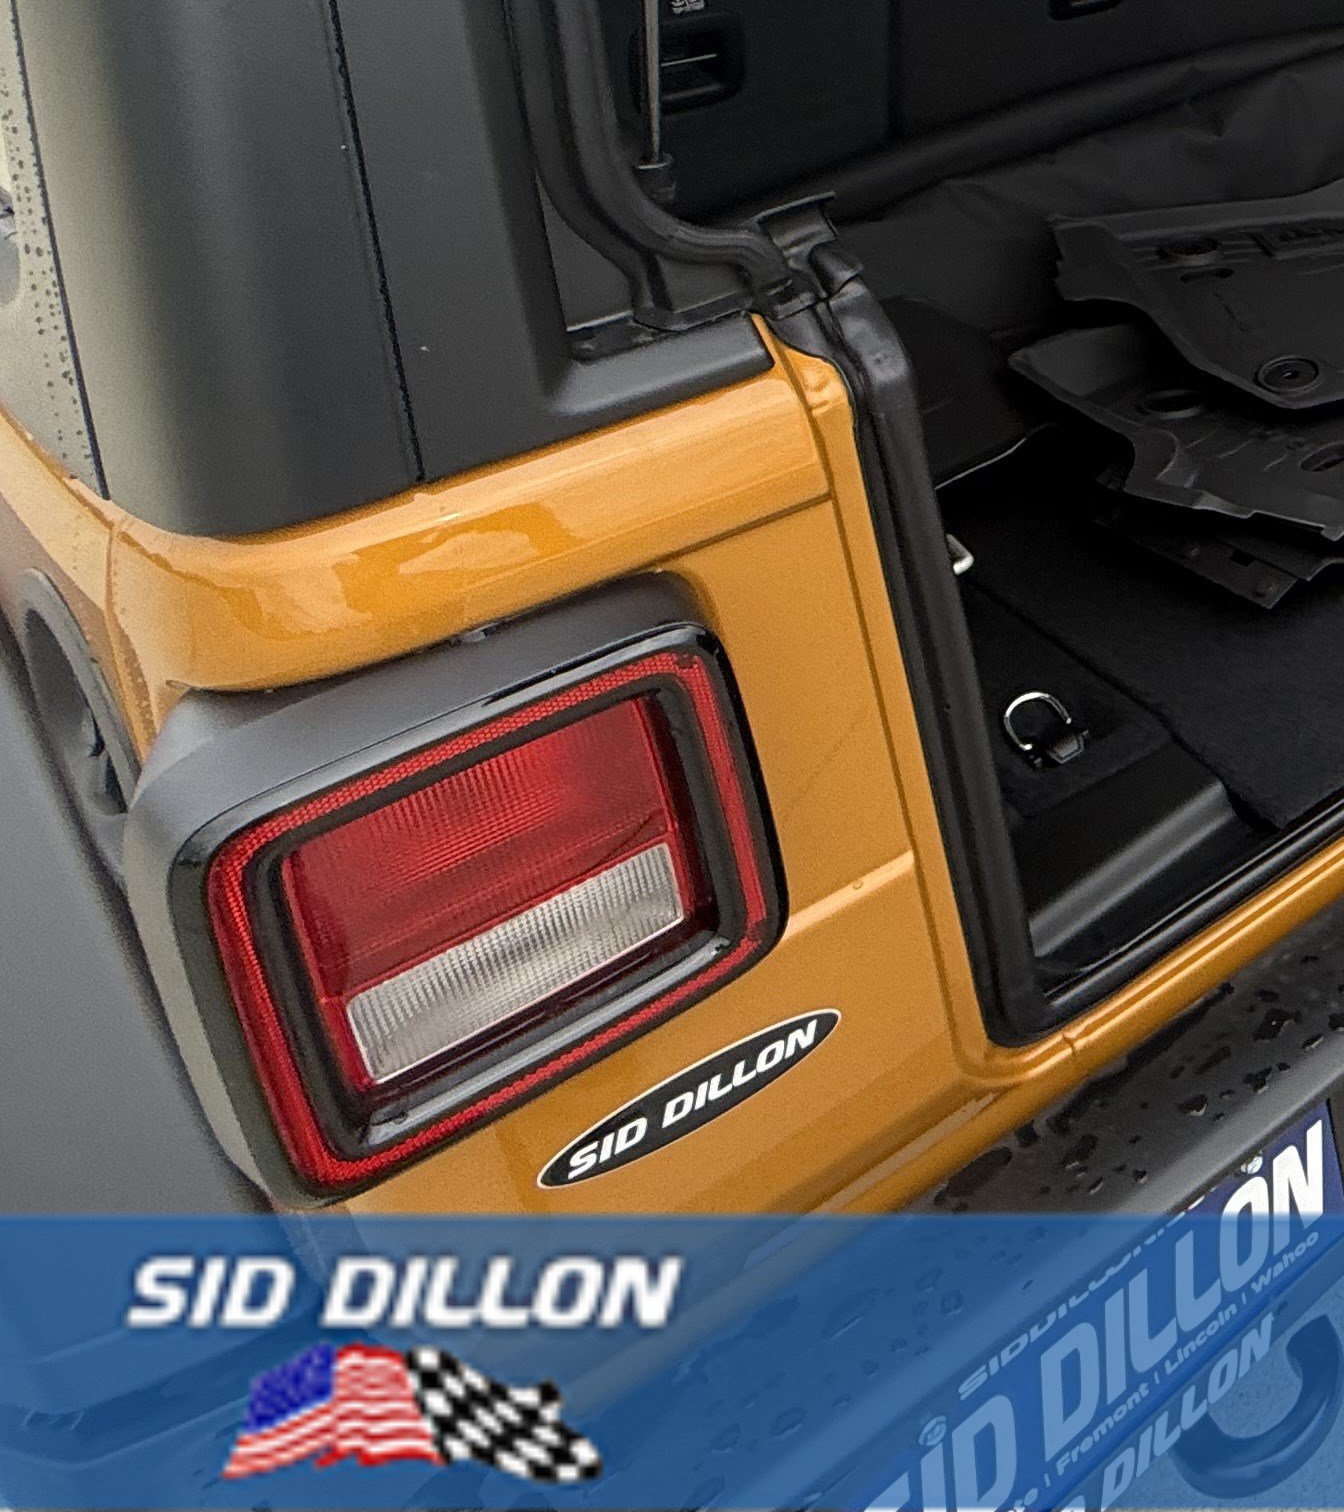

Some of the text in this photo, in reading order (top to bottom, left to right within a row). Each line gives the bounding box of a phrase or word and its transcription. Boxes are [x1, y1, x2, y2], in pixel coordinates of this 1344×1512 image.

[567, 1018, 818, 1180] SID DILLON
[1040, 1118, 1325, 1463] DILLON
[1056, 1231, 1320, 1476] Fremont Lincoln Wahoo
[1100, 1311, 1275, 1512] DILLON
